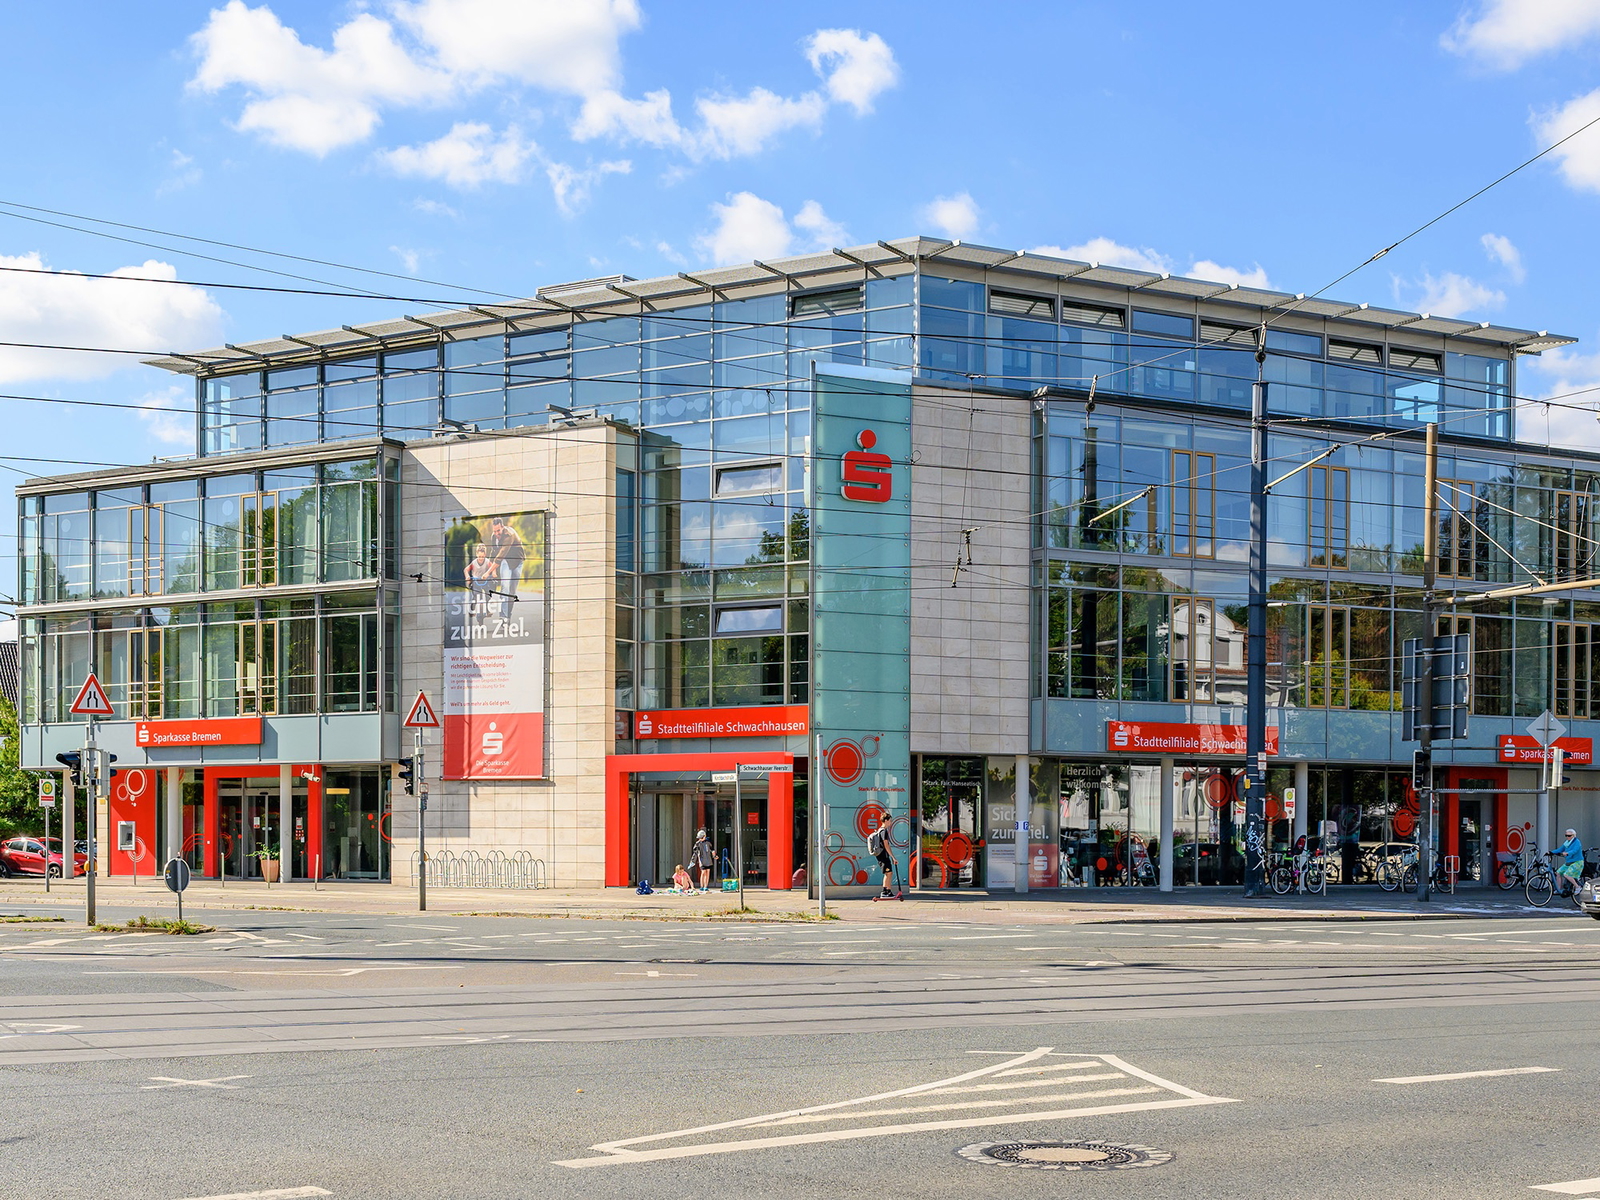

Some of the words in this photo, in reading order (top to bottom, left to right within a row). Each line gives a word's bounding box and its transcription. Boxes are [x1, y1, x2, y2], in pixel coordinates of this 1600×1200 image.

[451, 593, 505, 616] Sicher
[451, 625, 487, 640] zum
[492, 617, 530, 639] Ziel.
[658, 722, 724, 734] Stadtteilfiliale
[726, 721, 805, 732] Schwachhausen
[153, 733, 190, 744] Sparkasse
[192, 732, 221, 741] Bremen
[1134, 736, 1199, 748] Stadtteilfiliale
[1201, 737, 1273, 750] Schwachhen
[1520, 749, 1554, 760] Sparkass
[1066, 767, 1101, 776] Herzlich
